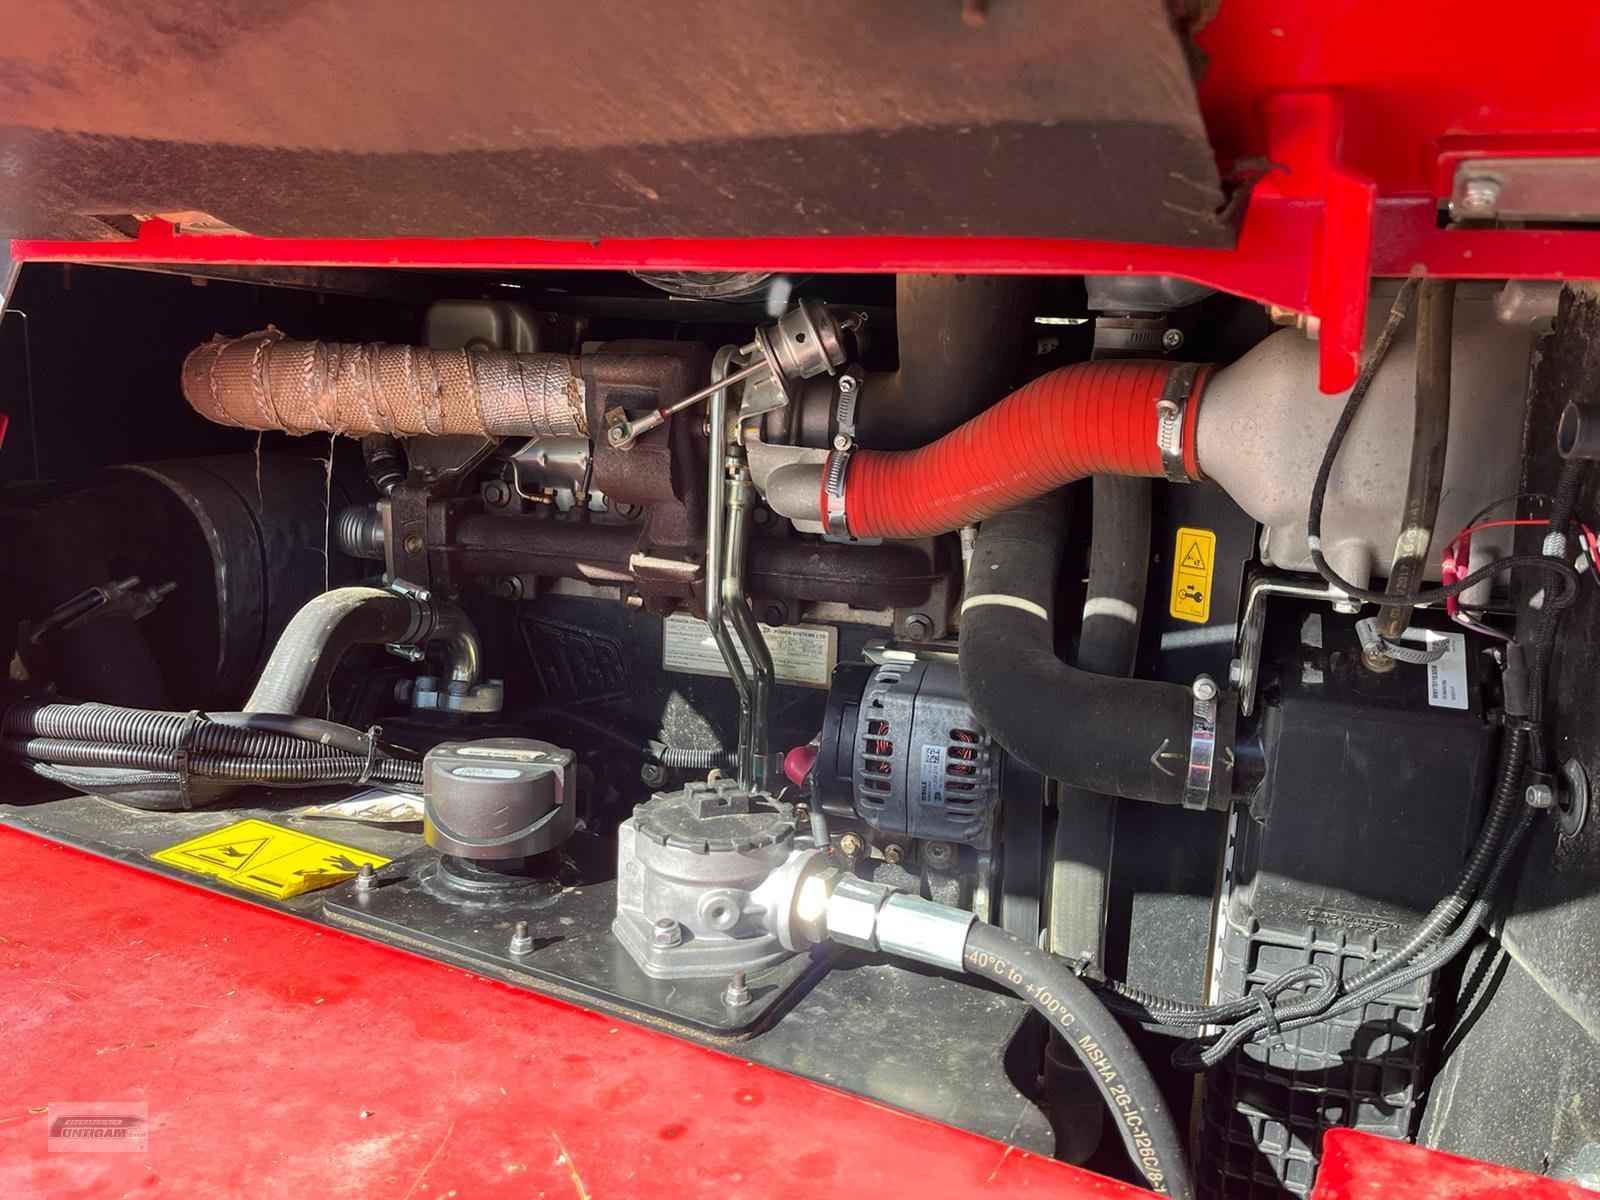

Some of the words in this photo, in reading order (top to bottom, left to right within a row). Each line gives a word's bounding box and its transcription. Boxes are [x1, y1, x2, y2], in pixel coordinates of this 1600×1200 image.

[964, 950, 1006, 975] -40°C
[1008, 967, 1022, 985] to
[1025, 983, 1076, 1028] +100°C
[1078, 1035, 1117, 1082] MSHA
